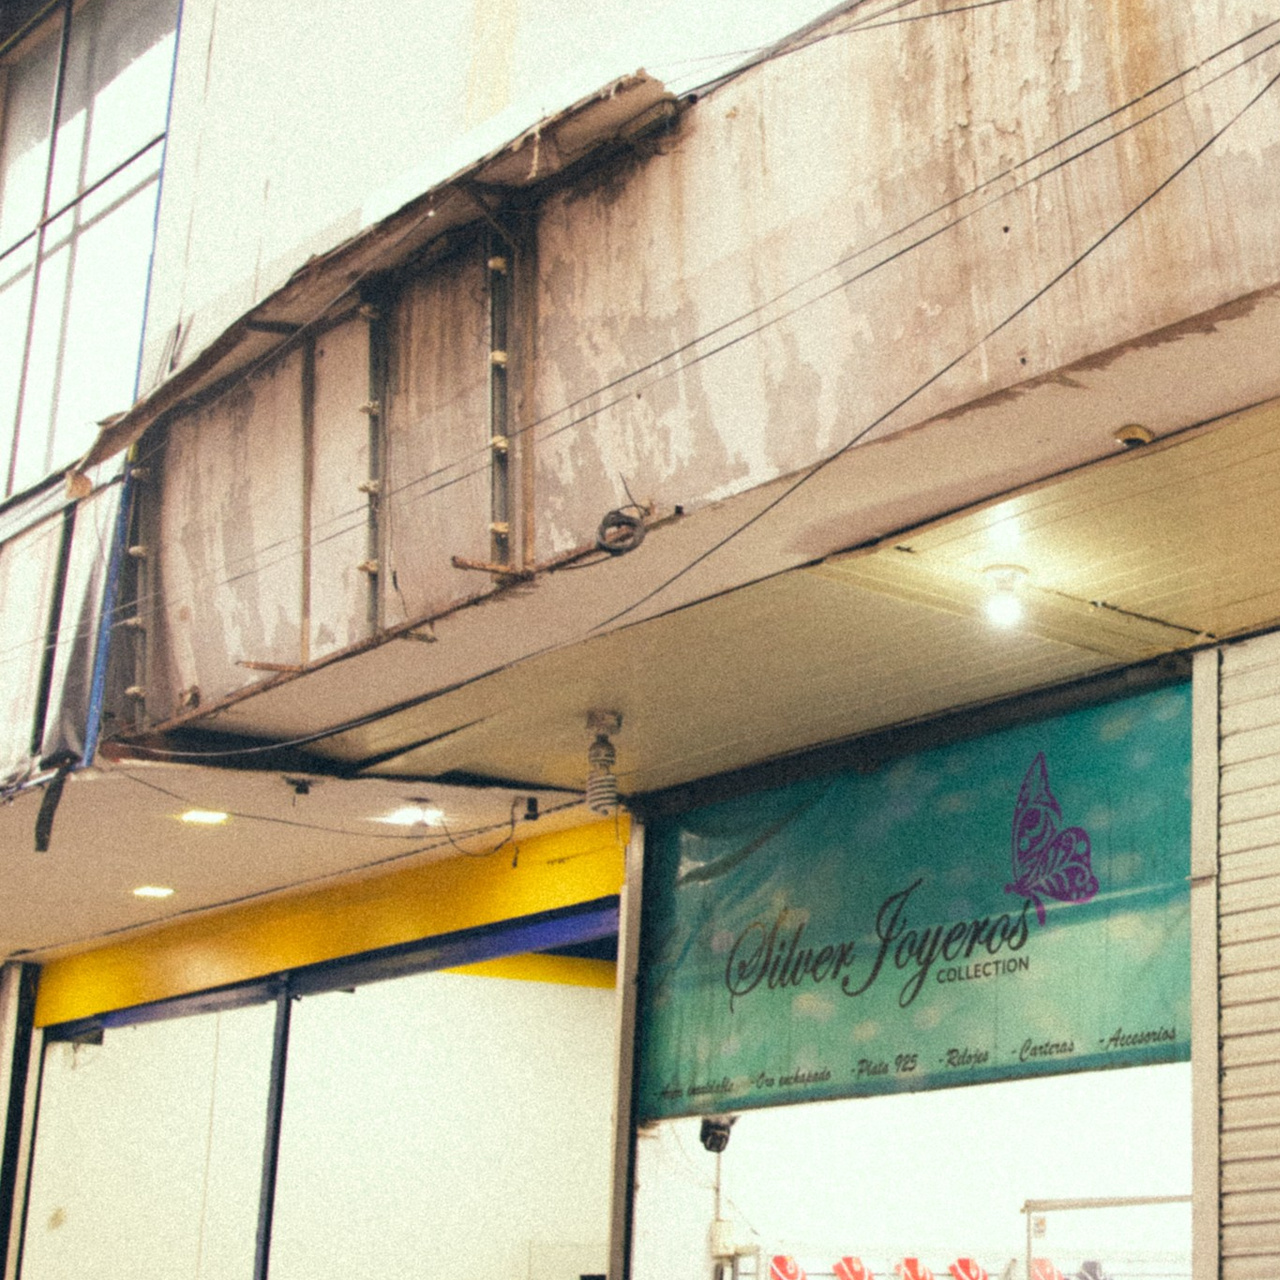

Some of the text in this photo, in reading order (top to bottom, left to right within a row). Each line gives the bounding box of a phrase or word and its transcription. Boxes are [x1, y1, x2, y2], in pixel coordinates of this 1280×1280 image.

[726, 877, 1031, 1014] Silver Joyeros
[936, 956, 1030, 984] COLLECTION
[894, 1053, 919, 1072] 925
